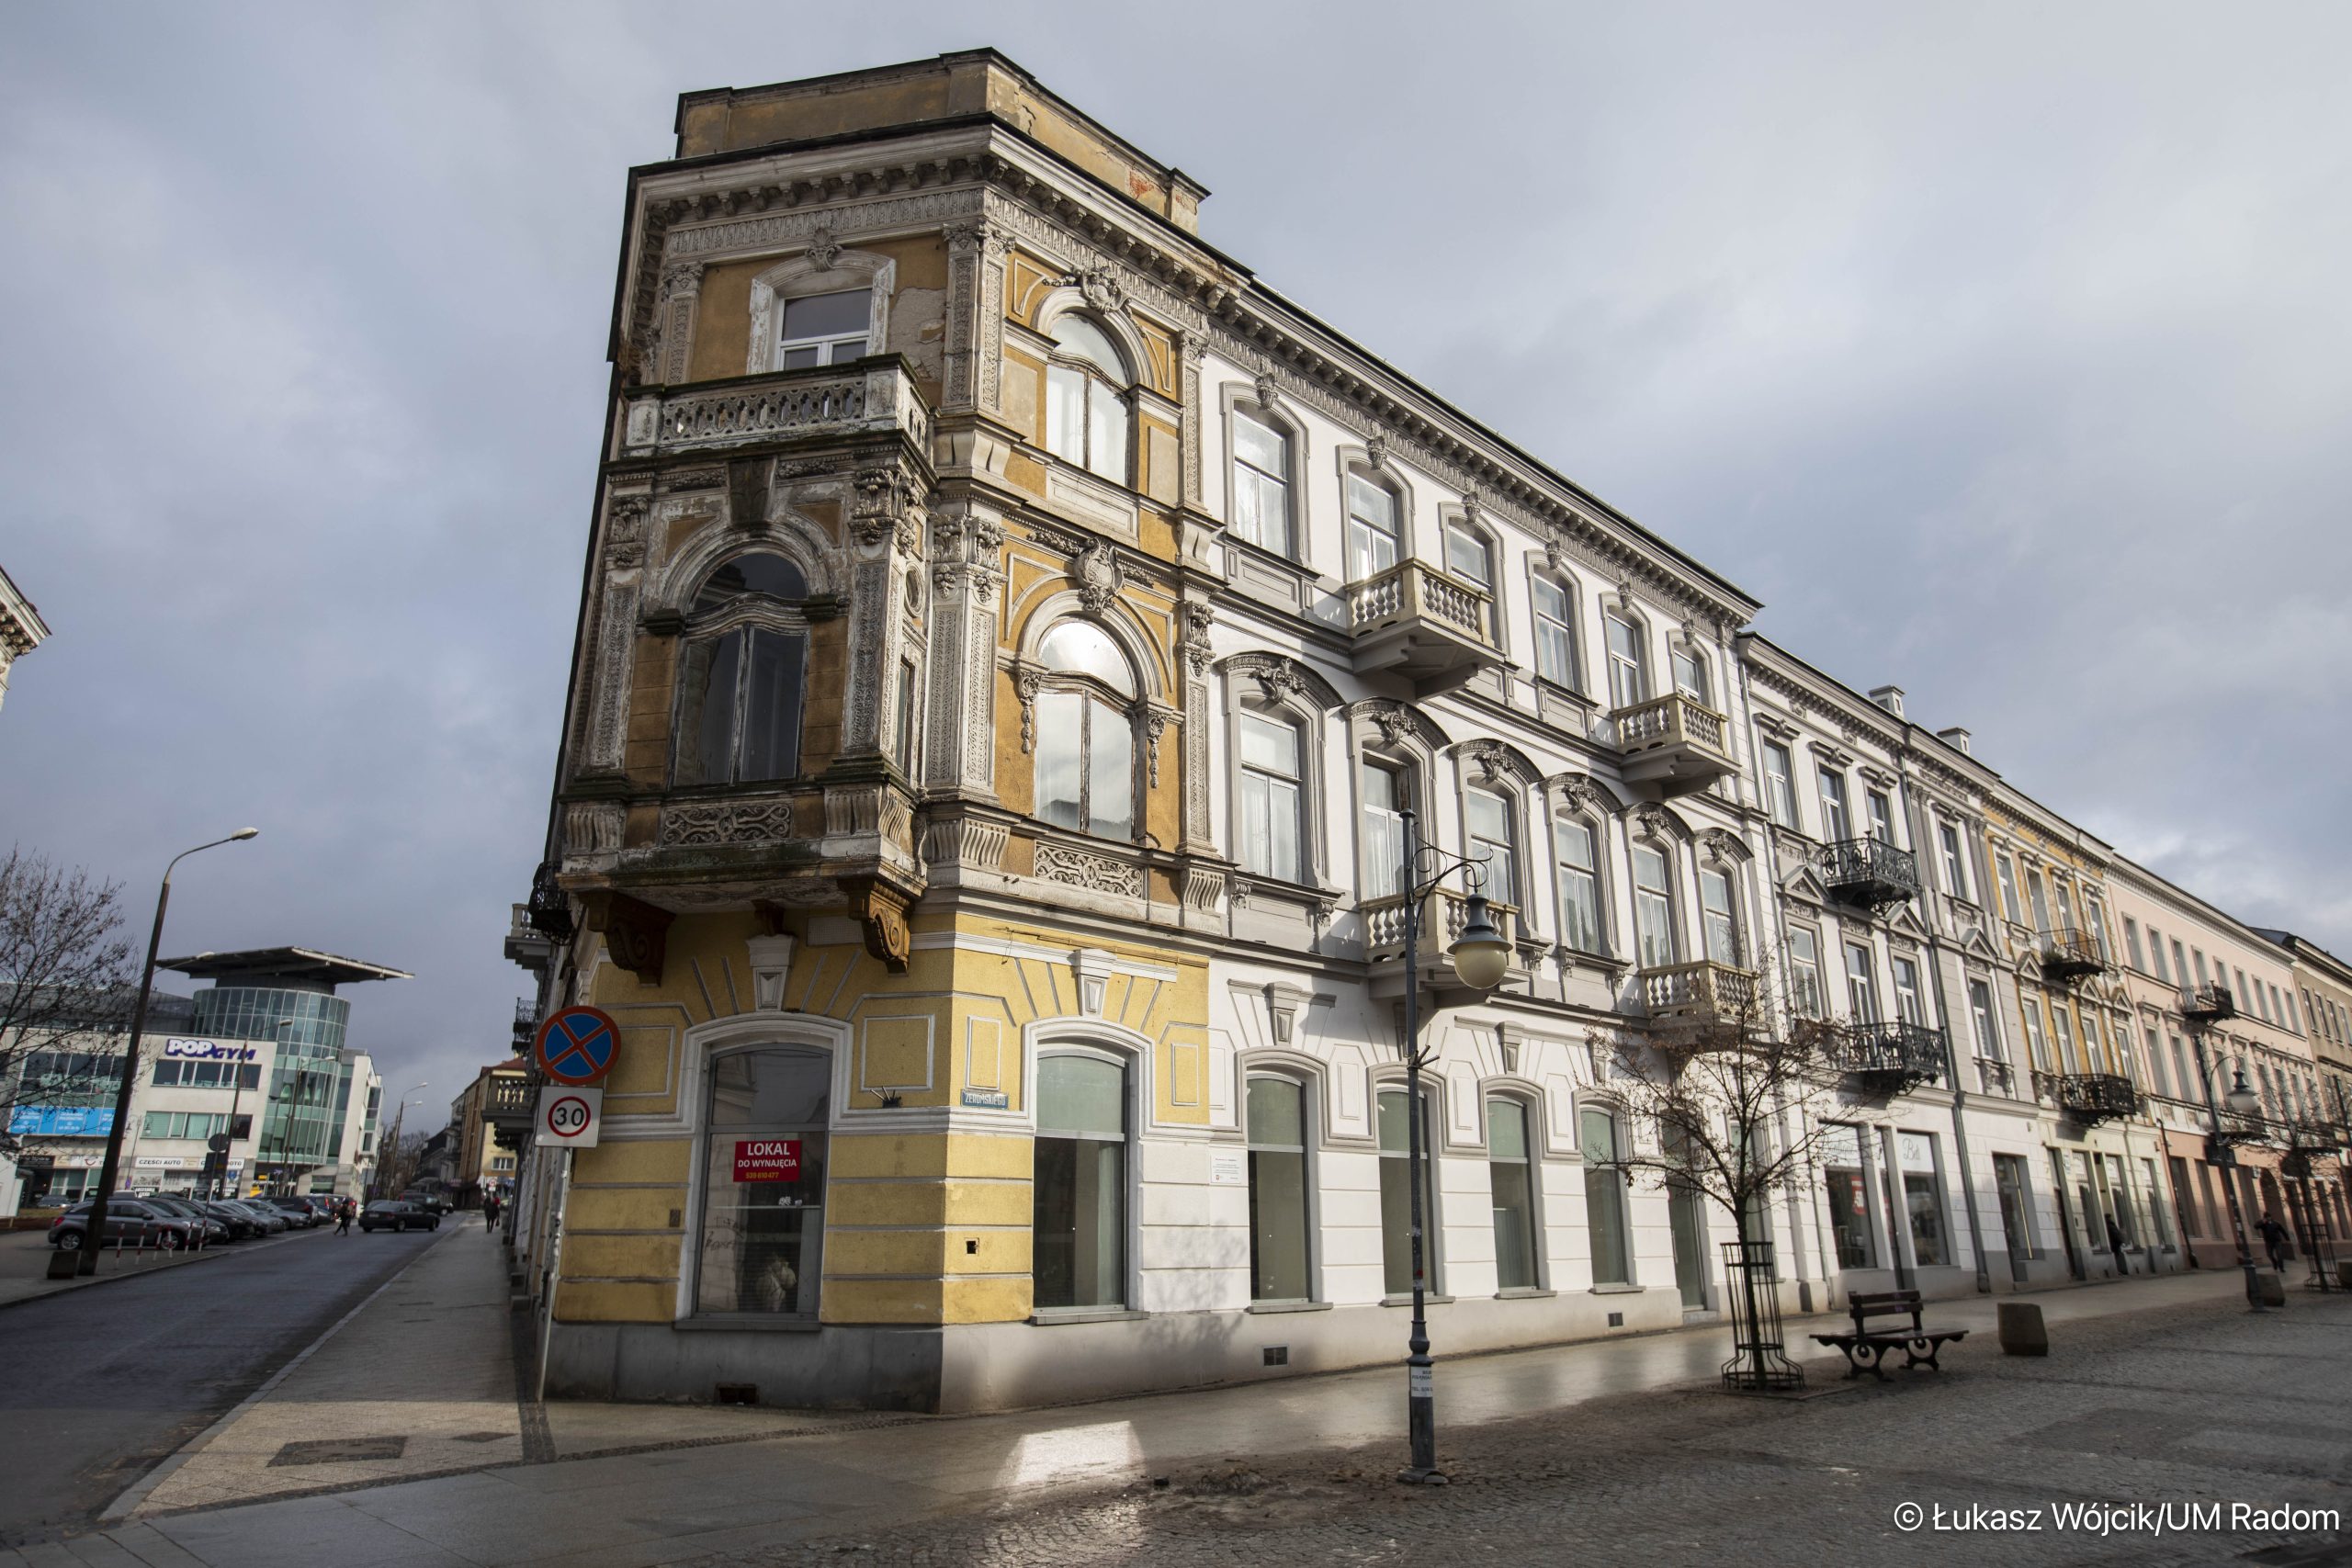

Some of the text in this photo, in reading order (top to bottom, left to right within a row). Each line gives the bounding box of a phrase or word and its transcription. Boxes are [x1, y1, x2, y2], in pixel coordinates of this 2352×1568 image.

[166, 1038, 256, 1060] POP GYM
[554, 1107, 584, 1126] 30
[747, 1142, 790, 1156] LOKAL
[738, 1158, 797, 1168] DO WYNAJĘCIA
